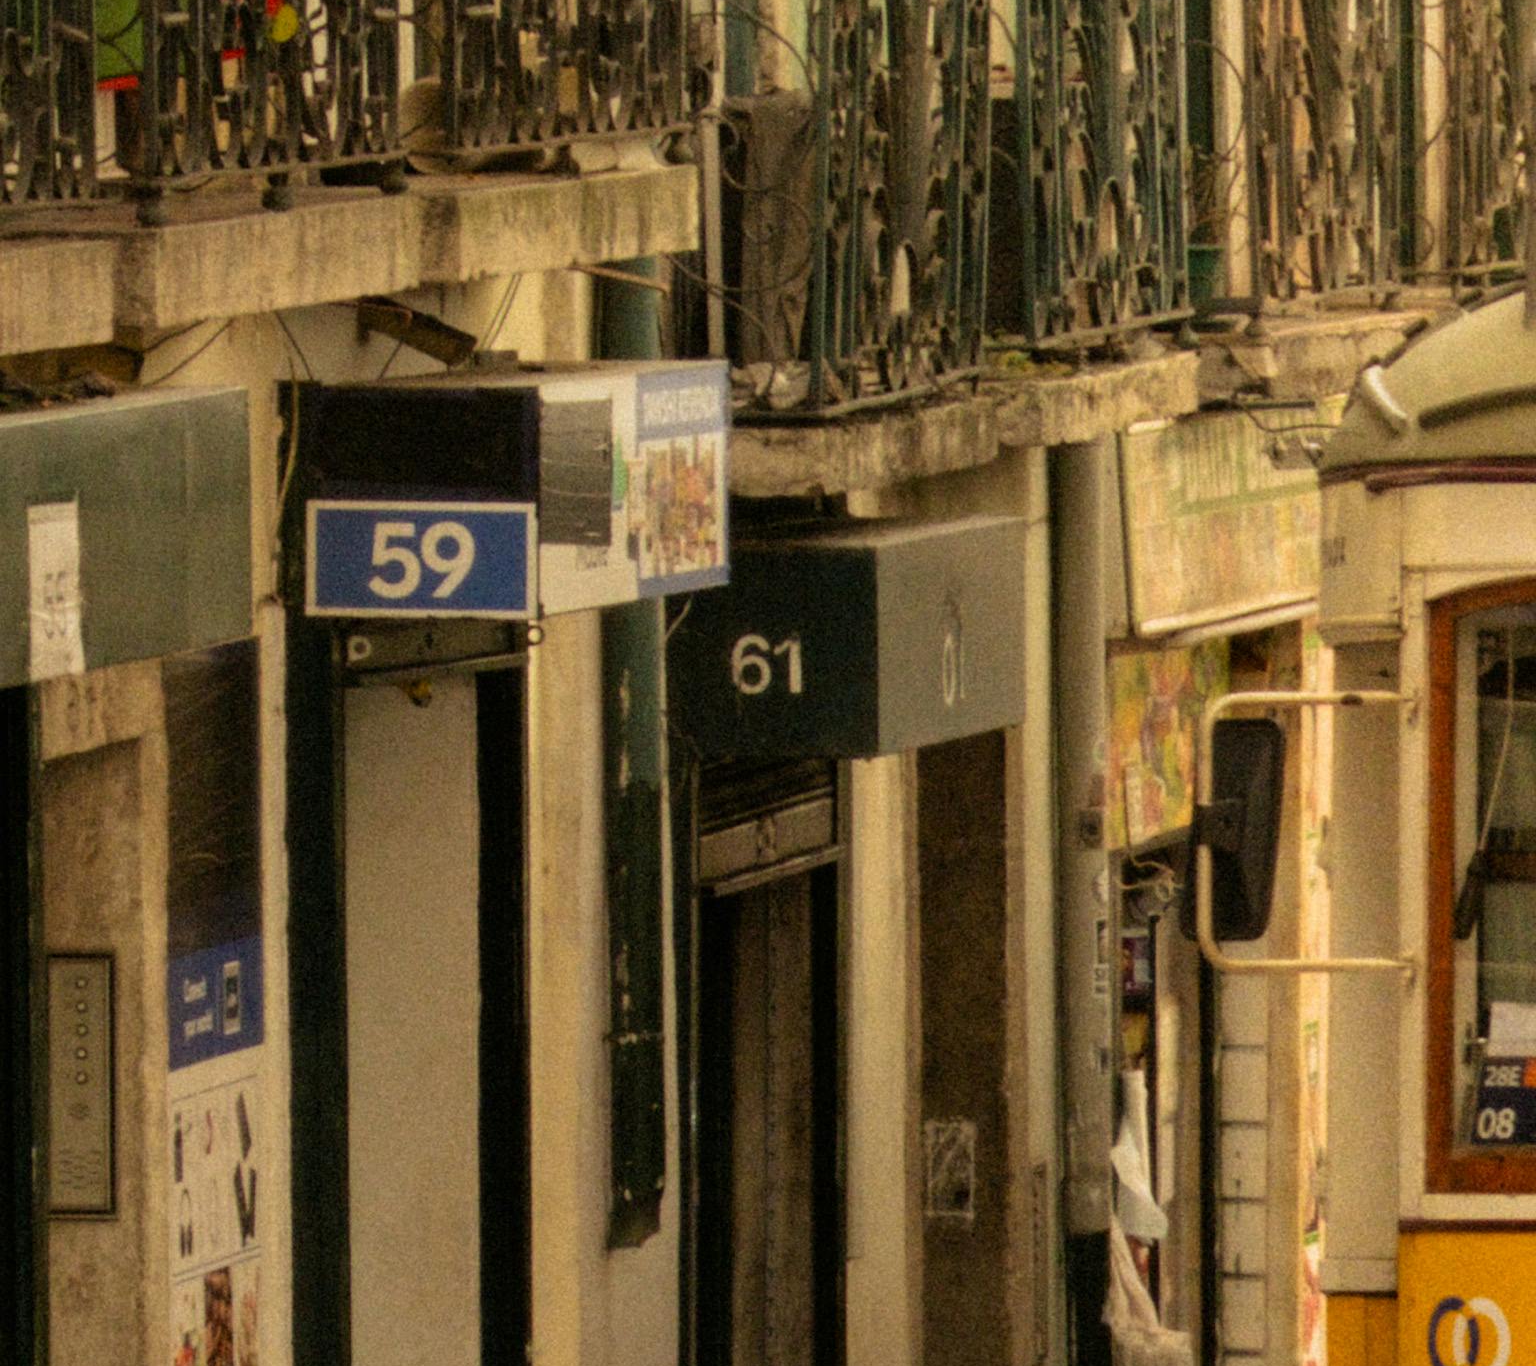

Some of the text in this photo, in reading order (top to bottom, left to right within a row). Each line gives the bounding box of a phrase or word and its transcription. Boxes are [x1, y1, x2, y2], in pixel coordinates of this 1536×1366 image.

[368, 521, 475, 599] 59
[731, 633, 802, 694] 61
[1484, 1064, 1523, 1087] 28E
[1477, 1107, 1516, 1140] 08
